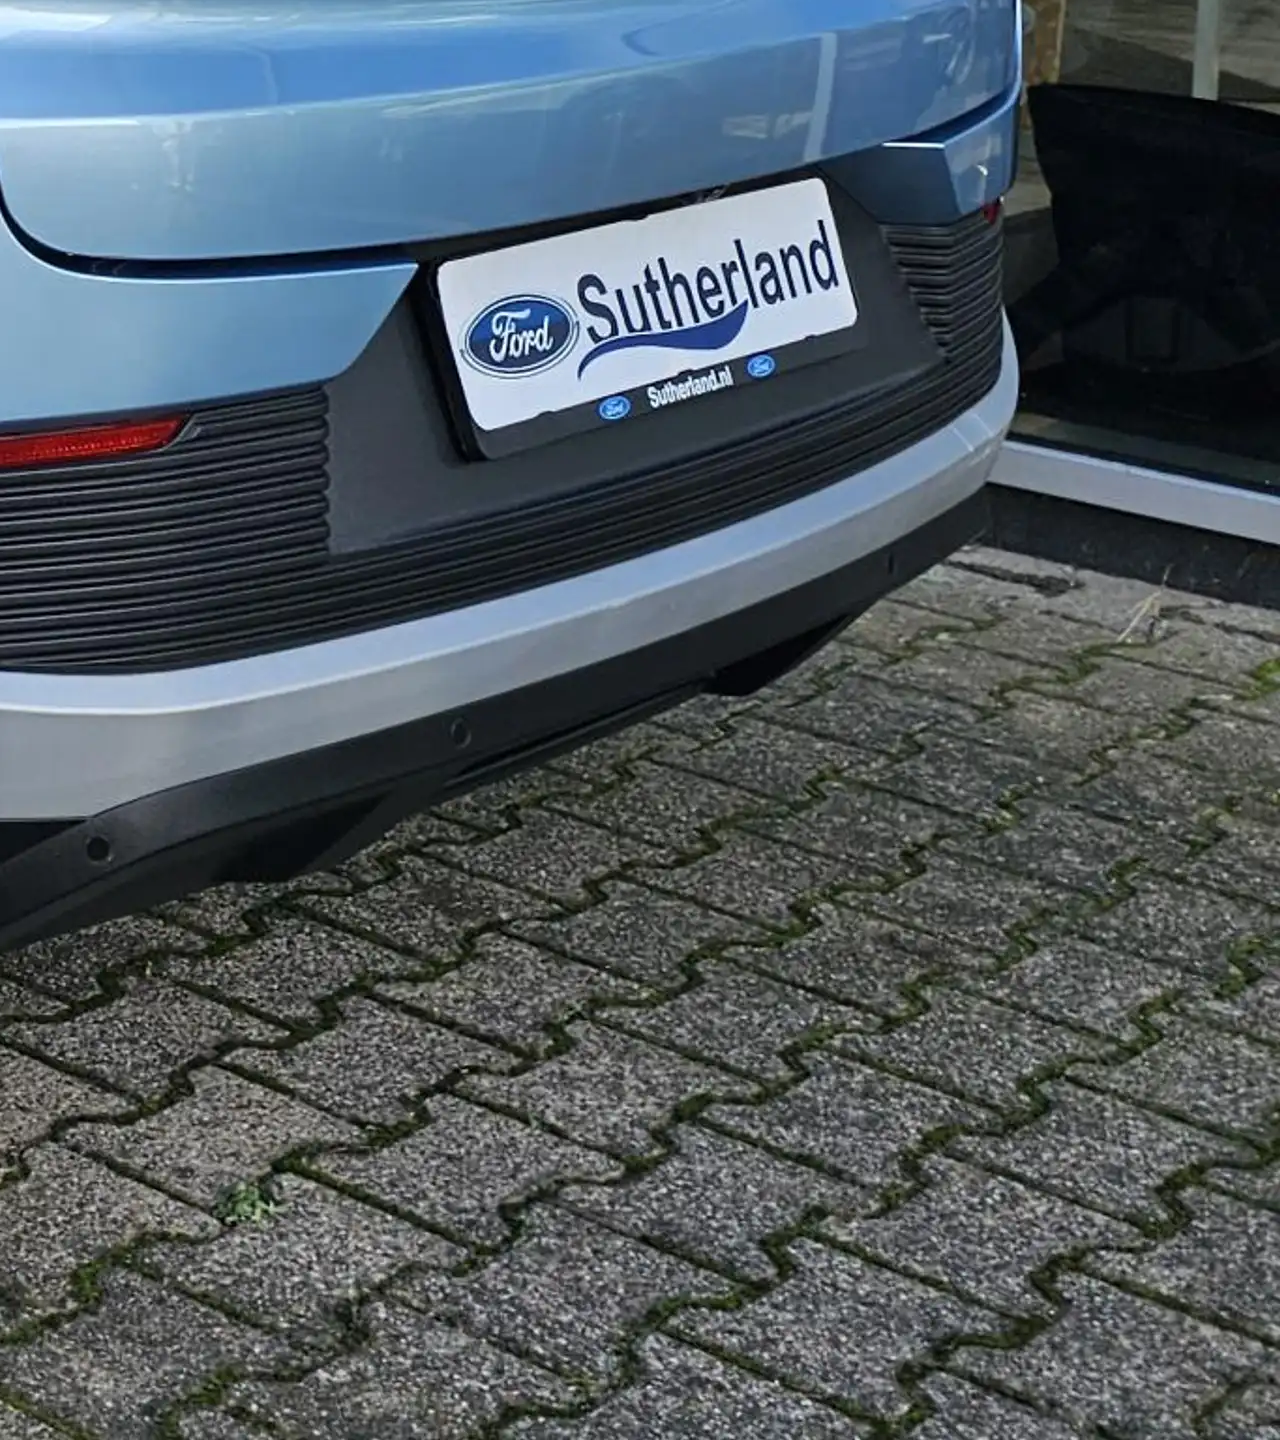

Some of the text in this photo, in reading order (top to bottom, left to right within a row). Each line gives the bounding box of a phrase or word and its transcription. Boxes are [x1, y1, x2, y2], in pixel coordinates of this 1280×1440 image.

[489, 219, 839, 362] Ford Sutherland
[647, 365, 734, 408] Sutherland.nl
